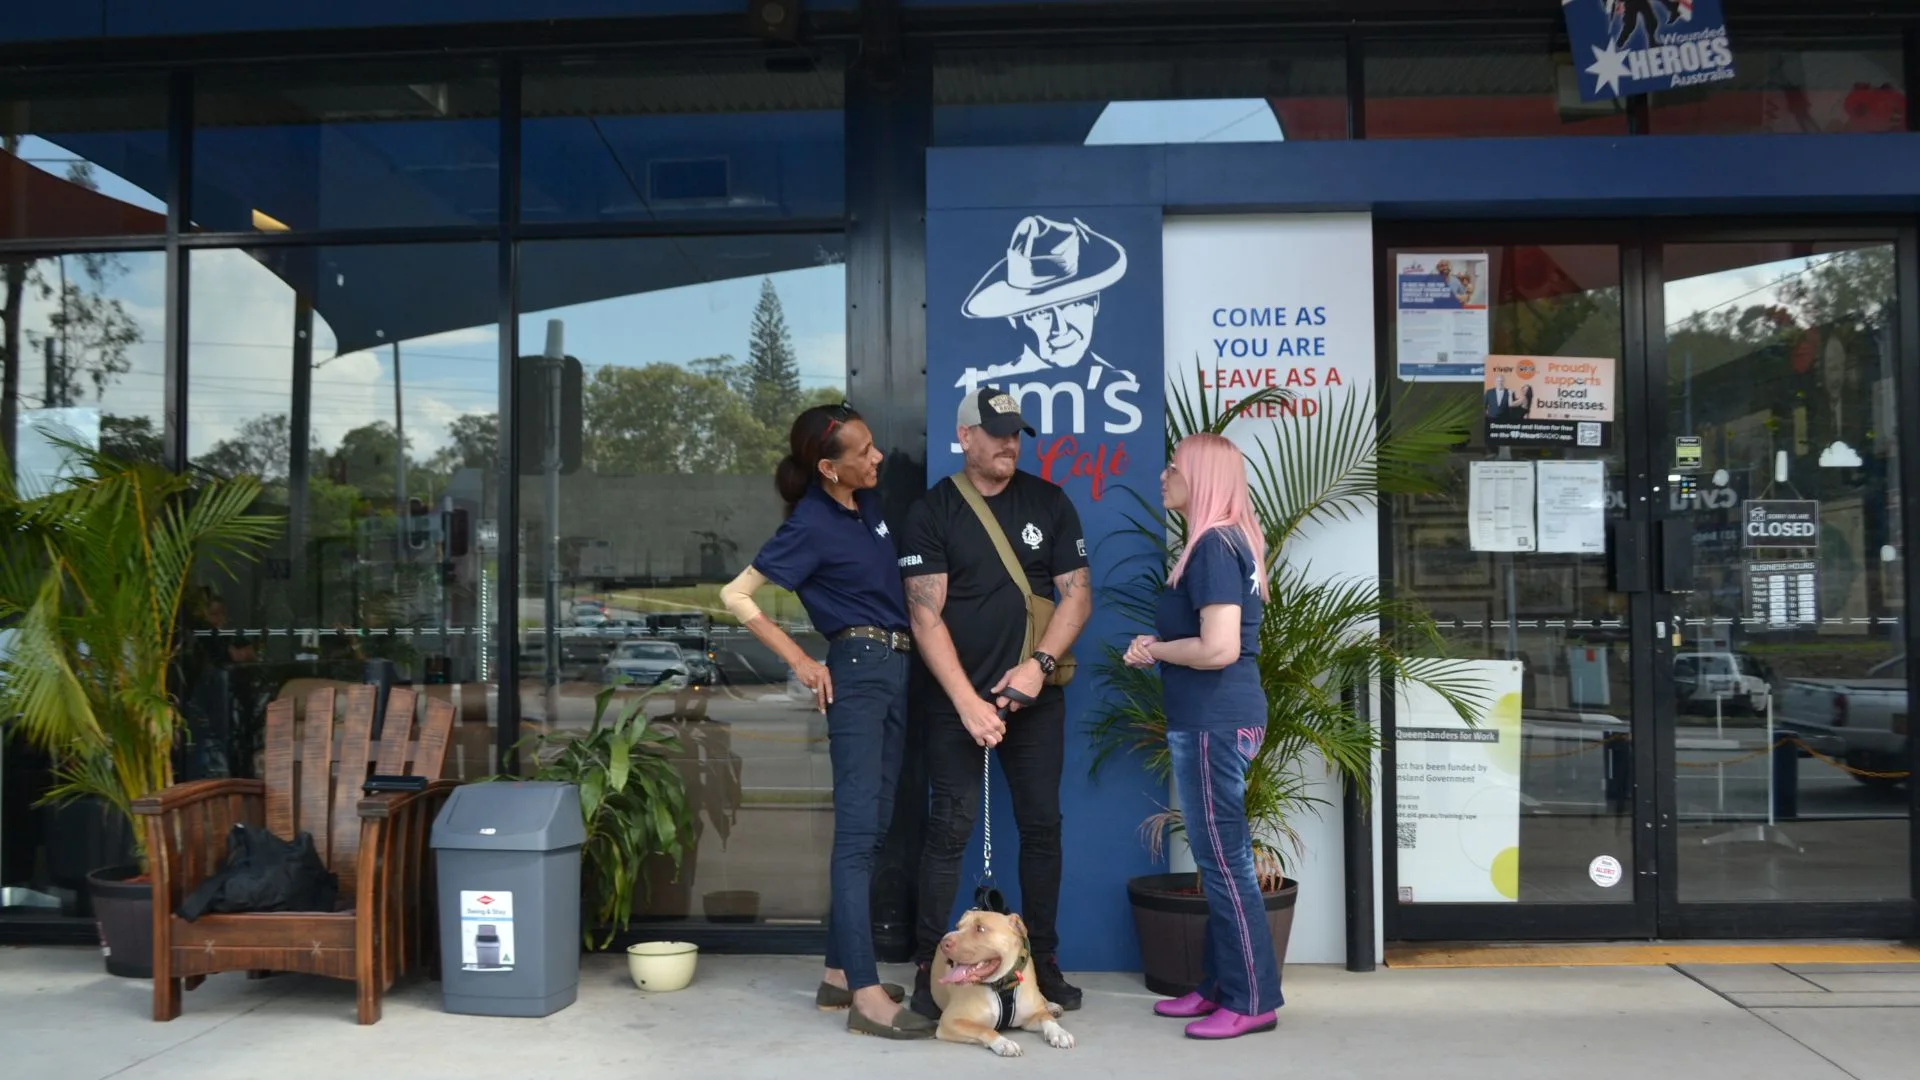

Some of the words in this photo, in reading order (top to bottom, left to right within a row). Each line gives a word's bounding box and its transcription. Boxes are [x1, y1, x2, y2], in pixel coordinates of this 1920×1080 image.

[1660, 24, 1726, 45] Wounded
[1628, 37, 1733, 80] HEROES
[1670, 68, 1736, 88] Australia
[1212, 307, 1287, 327] COME
[1295, 306, 1326, 326] AS
[1213, 338, 1268, 357] YOU
[1277, 337, 1326, 356] ARE
[1548, 362, 1598, 375] Proudly
[1200, 368, 1277, 389] LEAVE
[1285, 367, 1317, 387] AS
[1324, 367, 1343, 386] A
[1557, 387, 1588, 398] local
[1536, 398, 1608, 411] businesses.
[1037, 435, 1130, 502] Café
[1747, 522, 1815, 537] CLOSED
[1750, 563, 1787, 571] BUSINESS
[1787, 562, 1815, 570] HOURS
[1395, 730, 1459, 740] Queenslanders
[1460, 731, 1472, 740] for
[1473, 732, 1496, 741] Work
[1409, 761, 1423, 770] has
[1425, 762, 1446, 770] been
[1448, 762, 1475, 771] funded
[1478, 763, 1488, 773] by
[1426, 774, 1475, 783] Government
